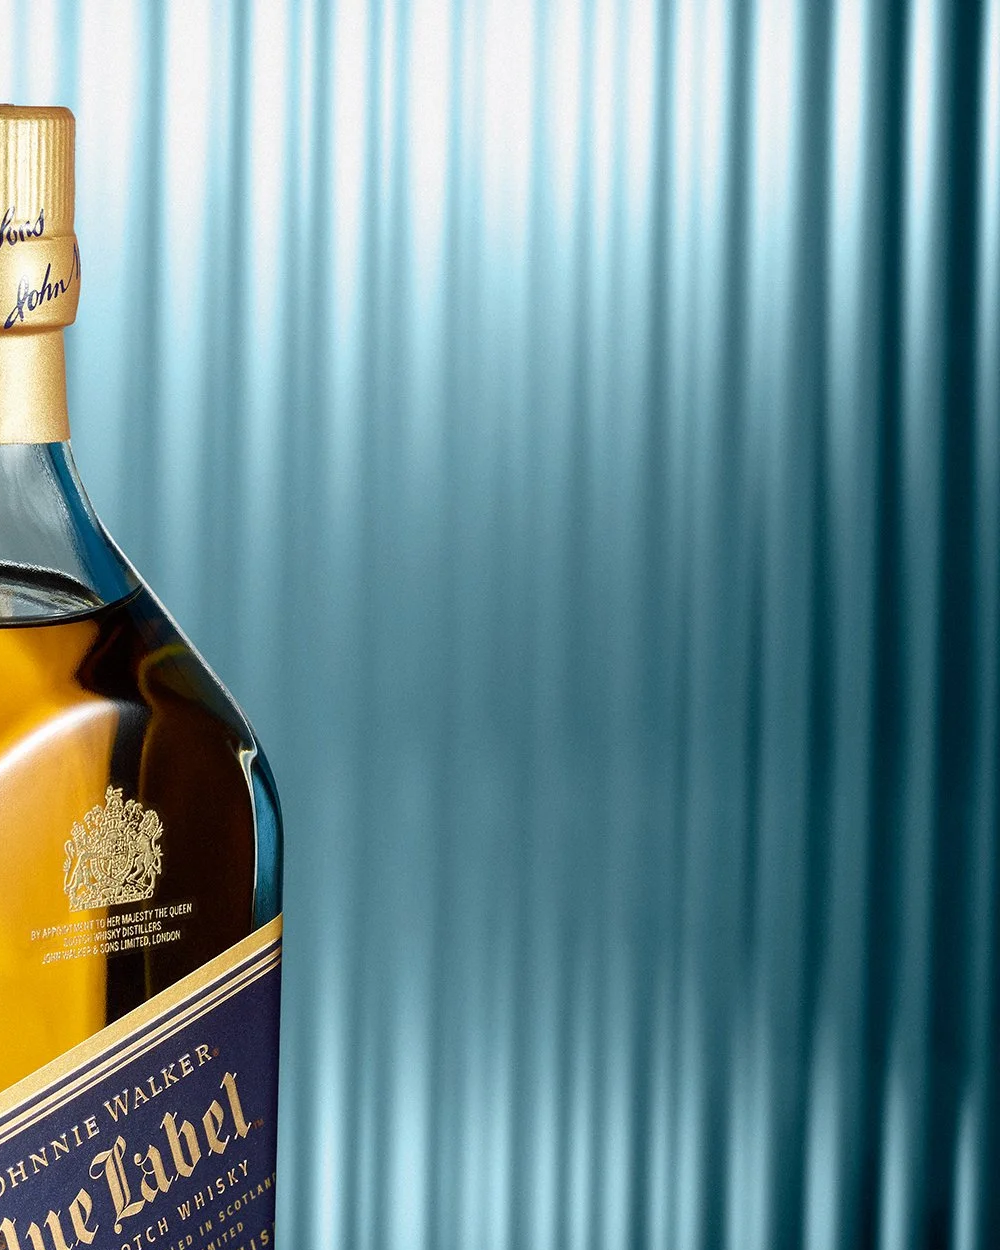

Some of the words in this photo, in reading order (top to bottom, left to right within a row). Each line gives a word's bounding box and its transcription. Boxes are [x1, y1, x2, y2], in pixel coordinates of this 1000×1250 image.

[3, 263, 69, 330] John
[96, 919, 106, 929] TO
[106, 915, 121, 928] HER
[121, 909, 154, 925] MAJESTY
[154, 906, 168, 919] THE
[168, 902, 193, 918] QUEEN
[93, 927, 121, 942] WHISKY
[122, 920, 162, 938] DISTILLERS
[93, 944, 99, 955] &
[99, 940, 120, 954] SONS
[120, 936, 151, 951] LIMITED,
[152, 929, 181, 946] LONDON
[88, 1071, 252, 1235] Label
[176, 1159, 248, 1221] WHISKY
[199, 1219, 213, 1237] IN
